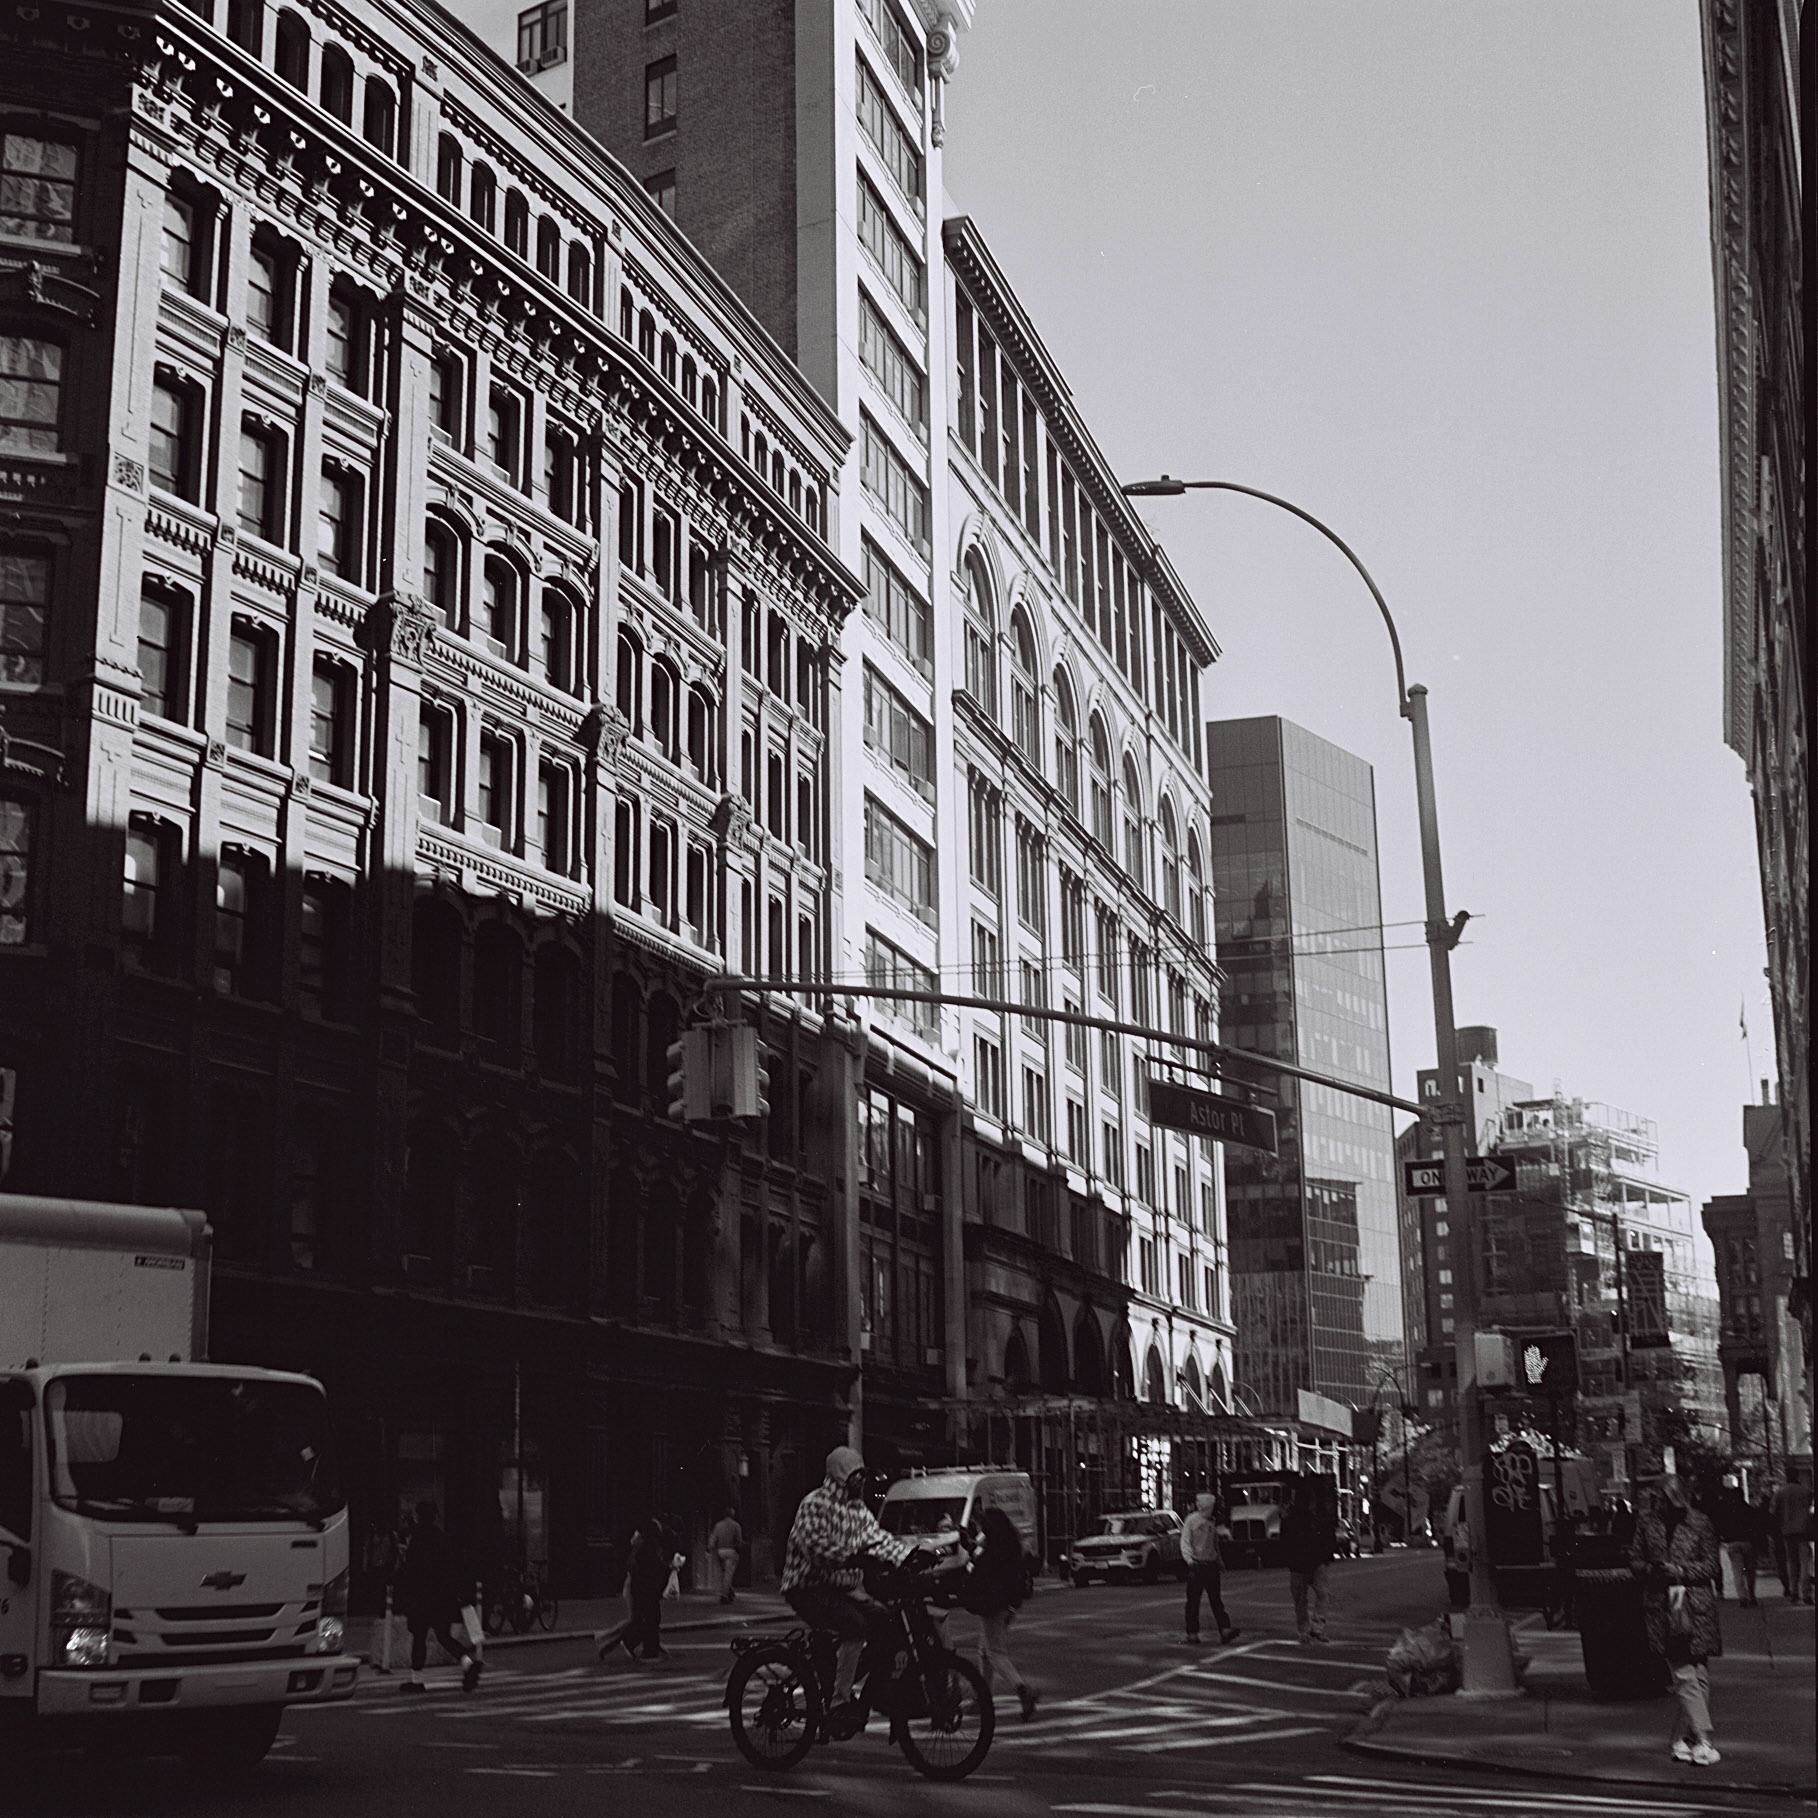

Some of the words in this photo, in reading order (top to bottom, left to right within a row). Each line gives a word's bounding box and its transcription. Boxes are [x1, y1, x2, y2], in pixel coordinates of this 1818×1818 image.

[1190, 1101, 1225, 1131] Astor
[1231, 1112, 1245, 1137] Pl
[1420, 1170, 1442, 1185] ON
[1466, 1167, 1498, 1182] WAY
